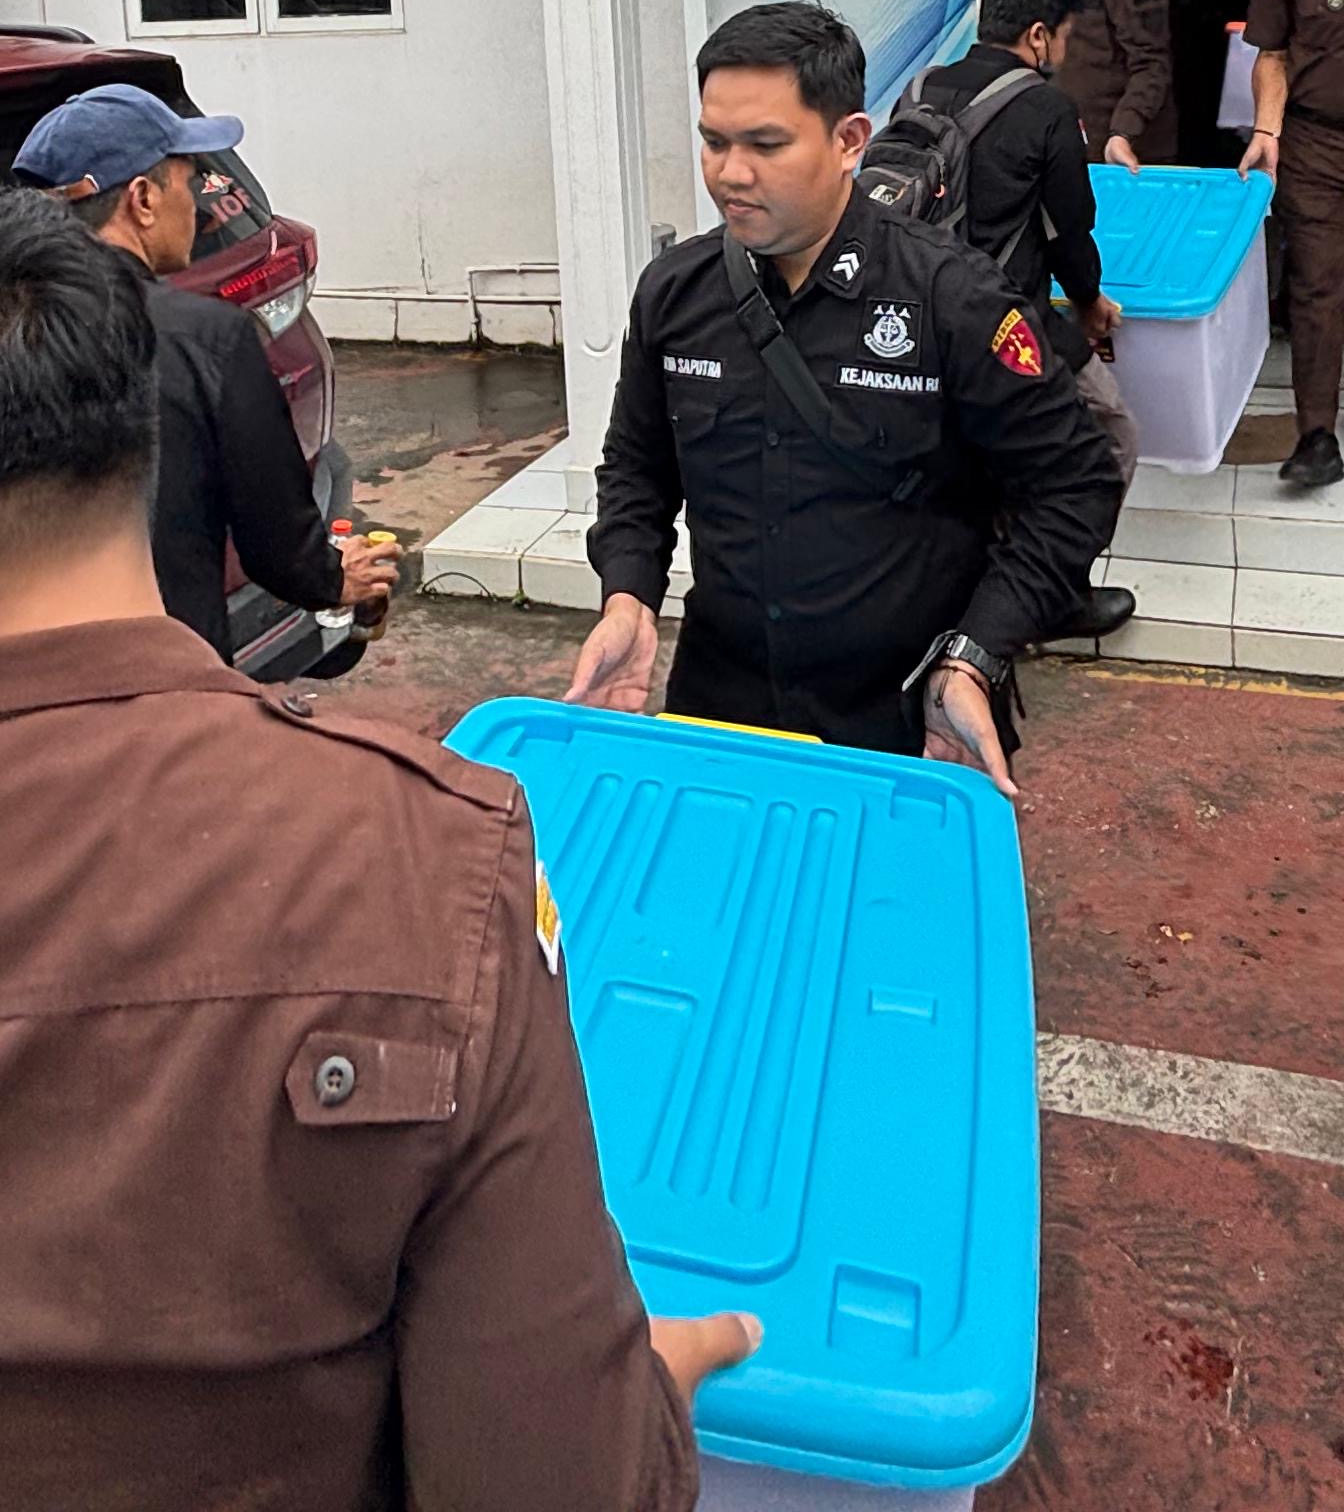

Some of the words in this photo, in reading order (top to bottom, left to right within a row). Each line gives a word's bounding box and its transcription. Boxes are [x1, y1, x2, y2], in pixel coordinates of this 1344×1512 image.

[677, 357, 721, 378] SAPUTRA
[840, 367, 923, 391] KEJAKSAAN
[925, 377, 939, 392] RI
